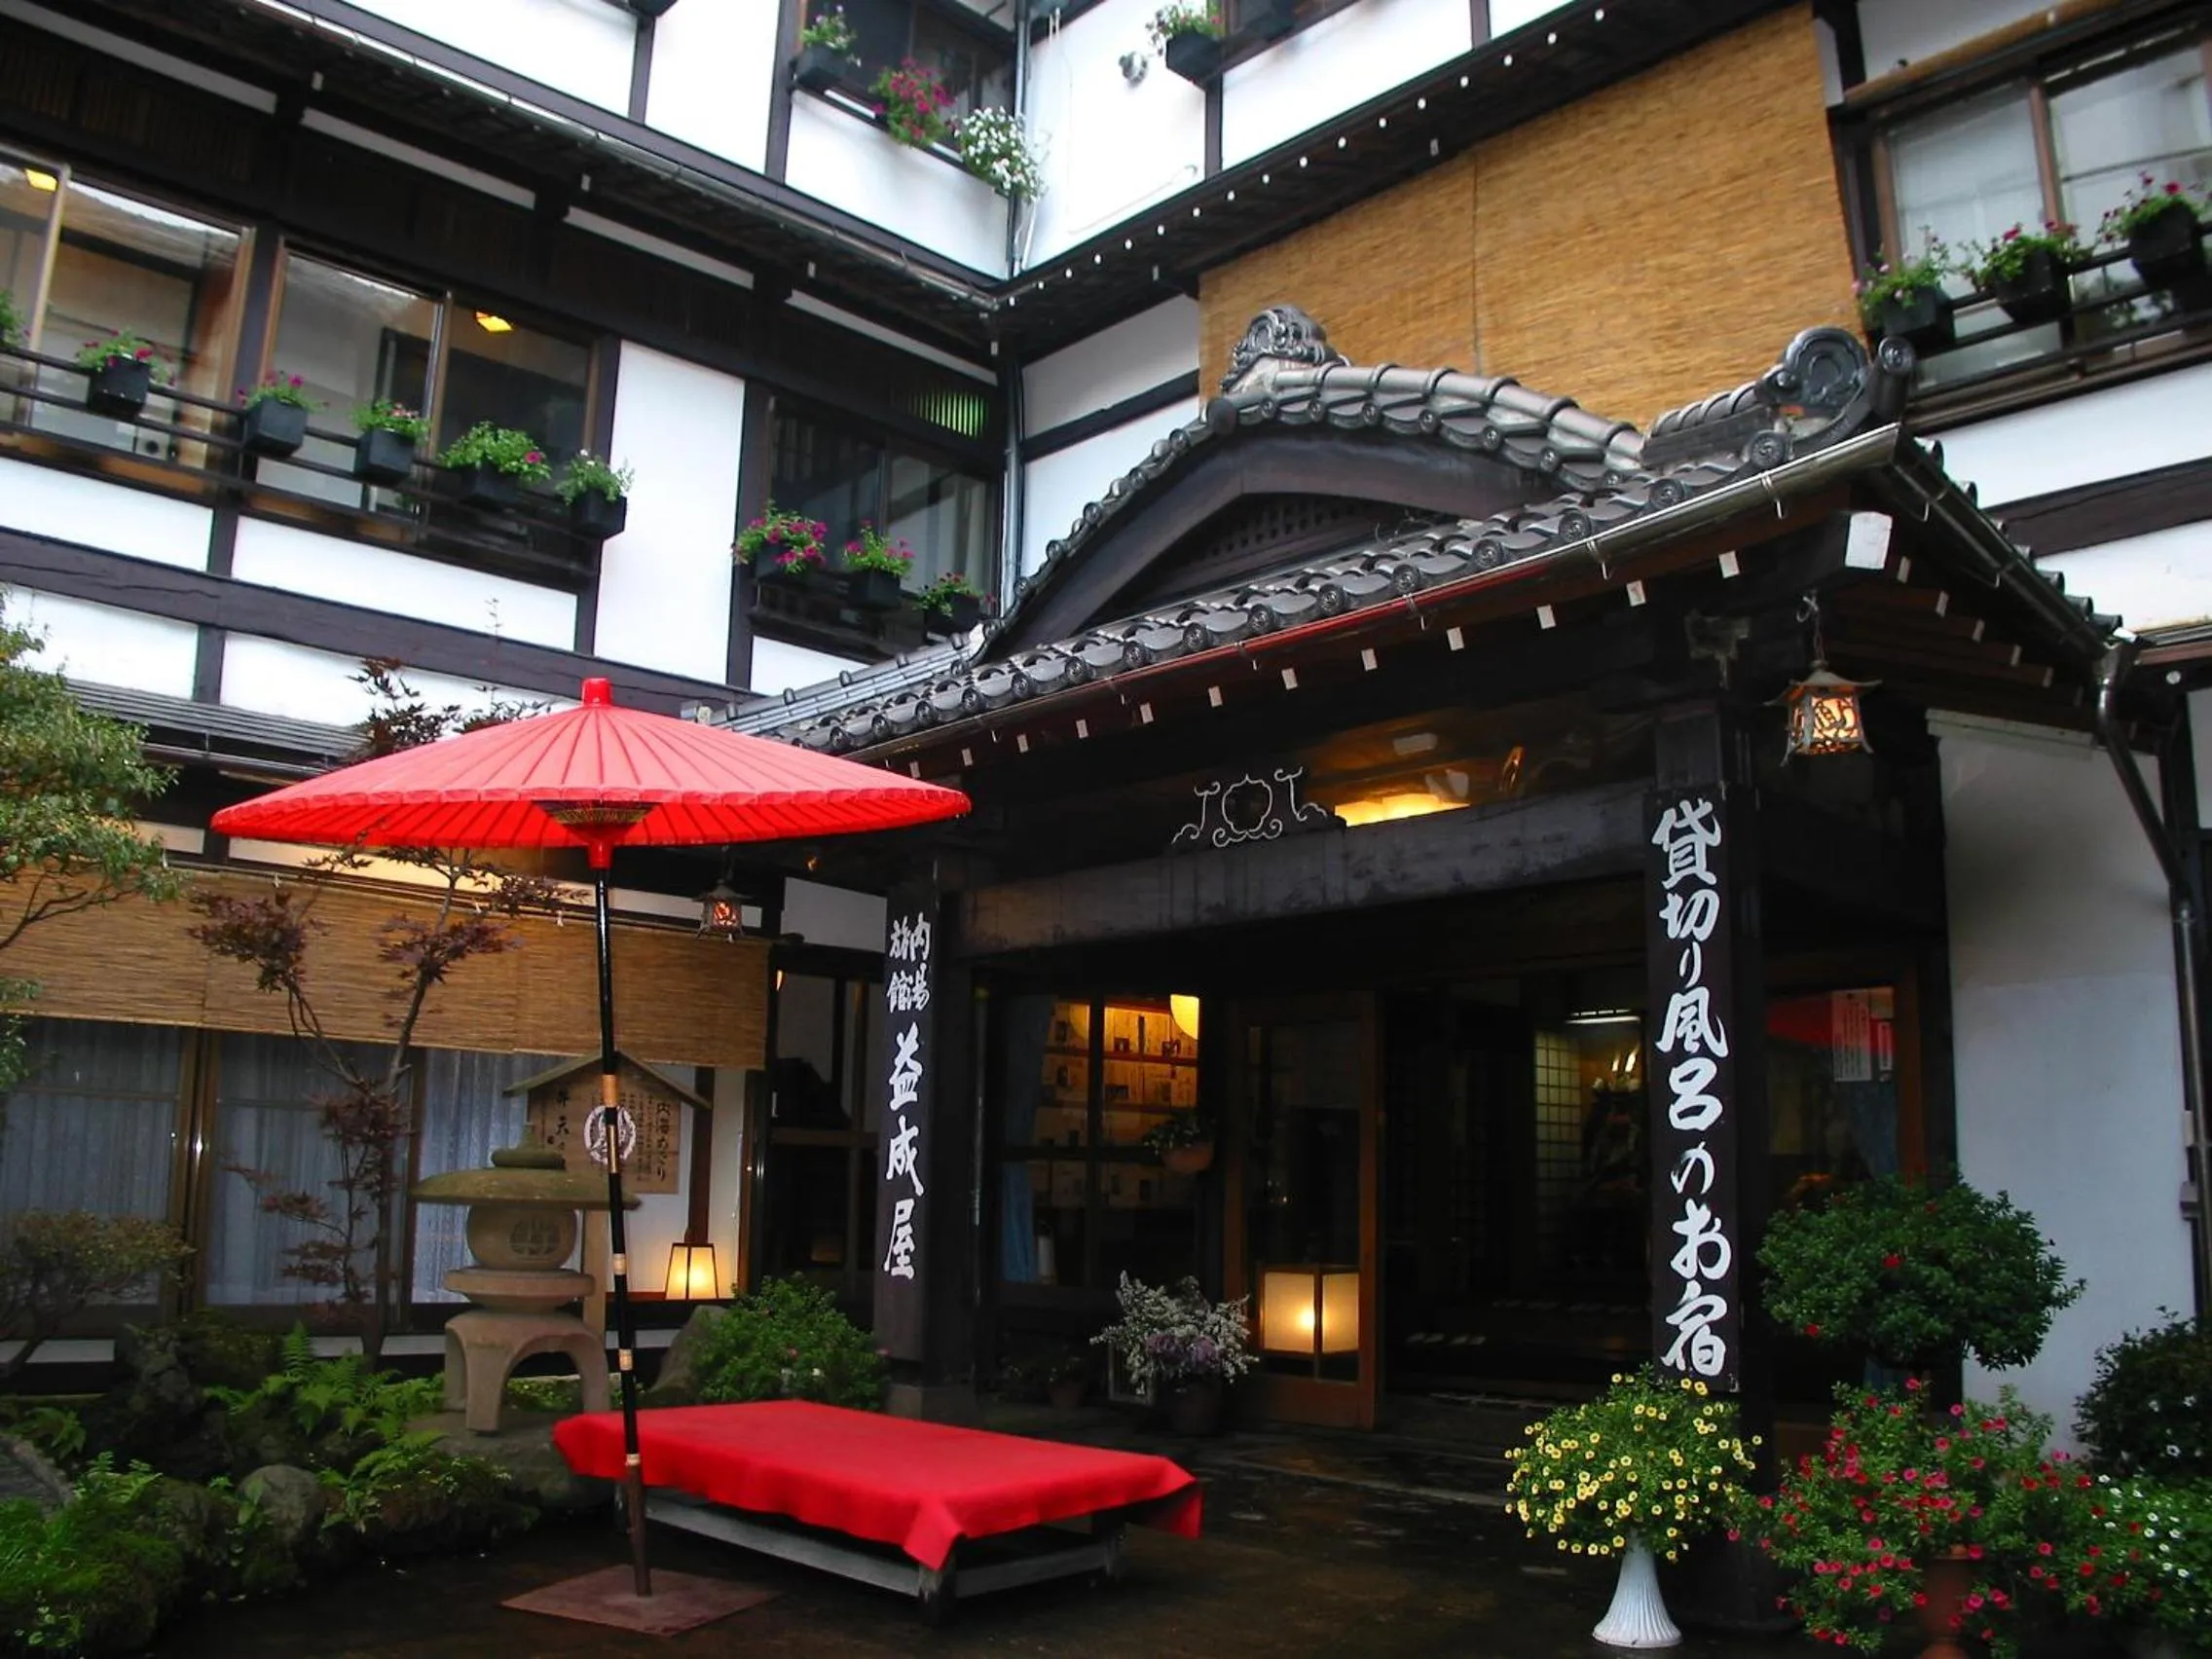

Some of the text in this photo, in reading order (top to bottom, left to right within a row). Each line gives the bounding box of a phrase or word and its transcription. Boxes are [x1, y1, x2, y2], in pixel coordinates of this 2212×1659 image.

[883, 1021, 924, 1280] 益成屋
[1651, 797, 1732, 1378] 貸切り風呂のお宿
